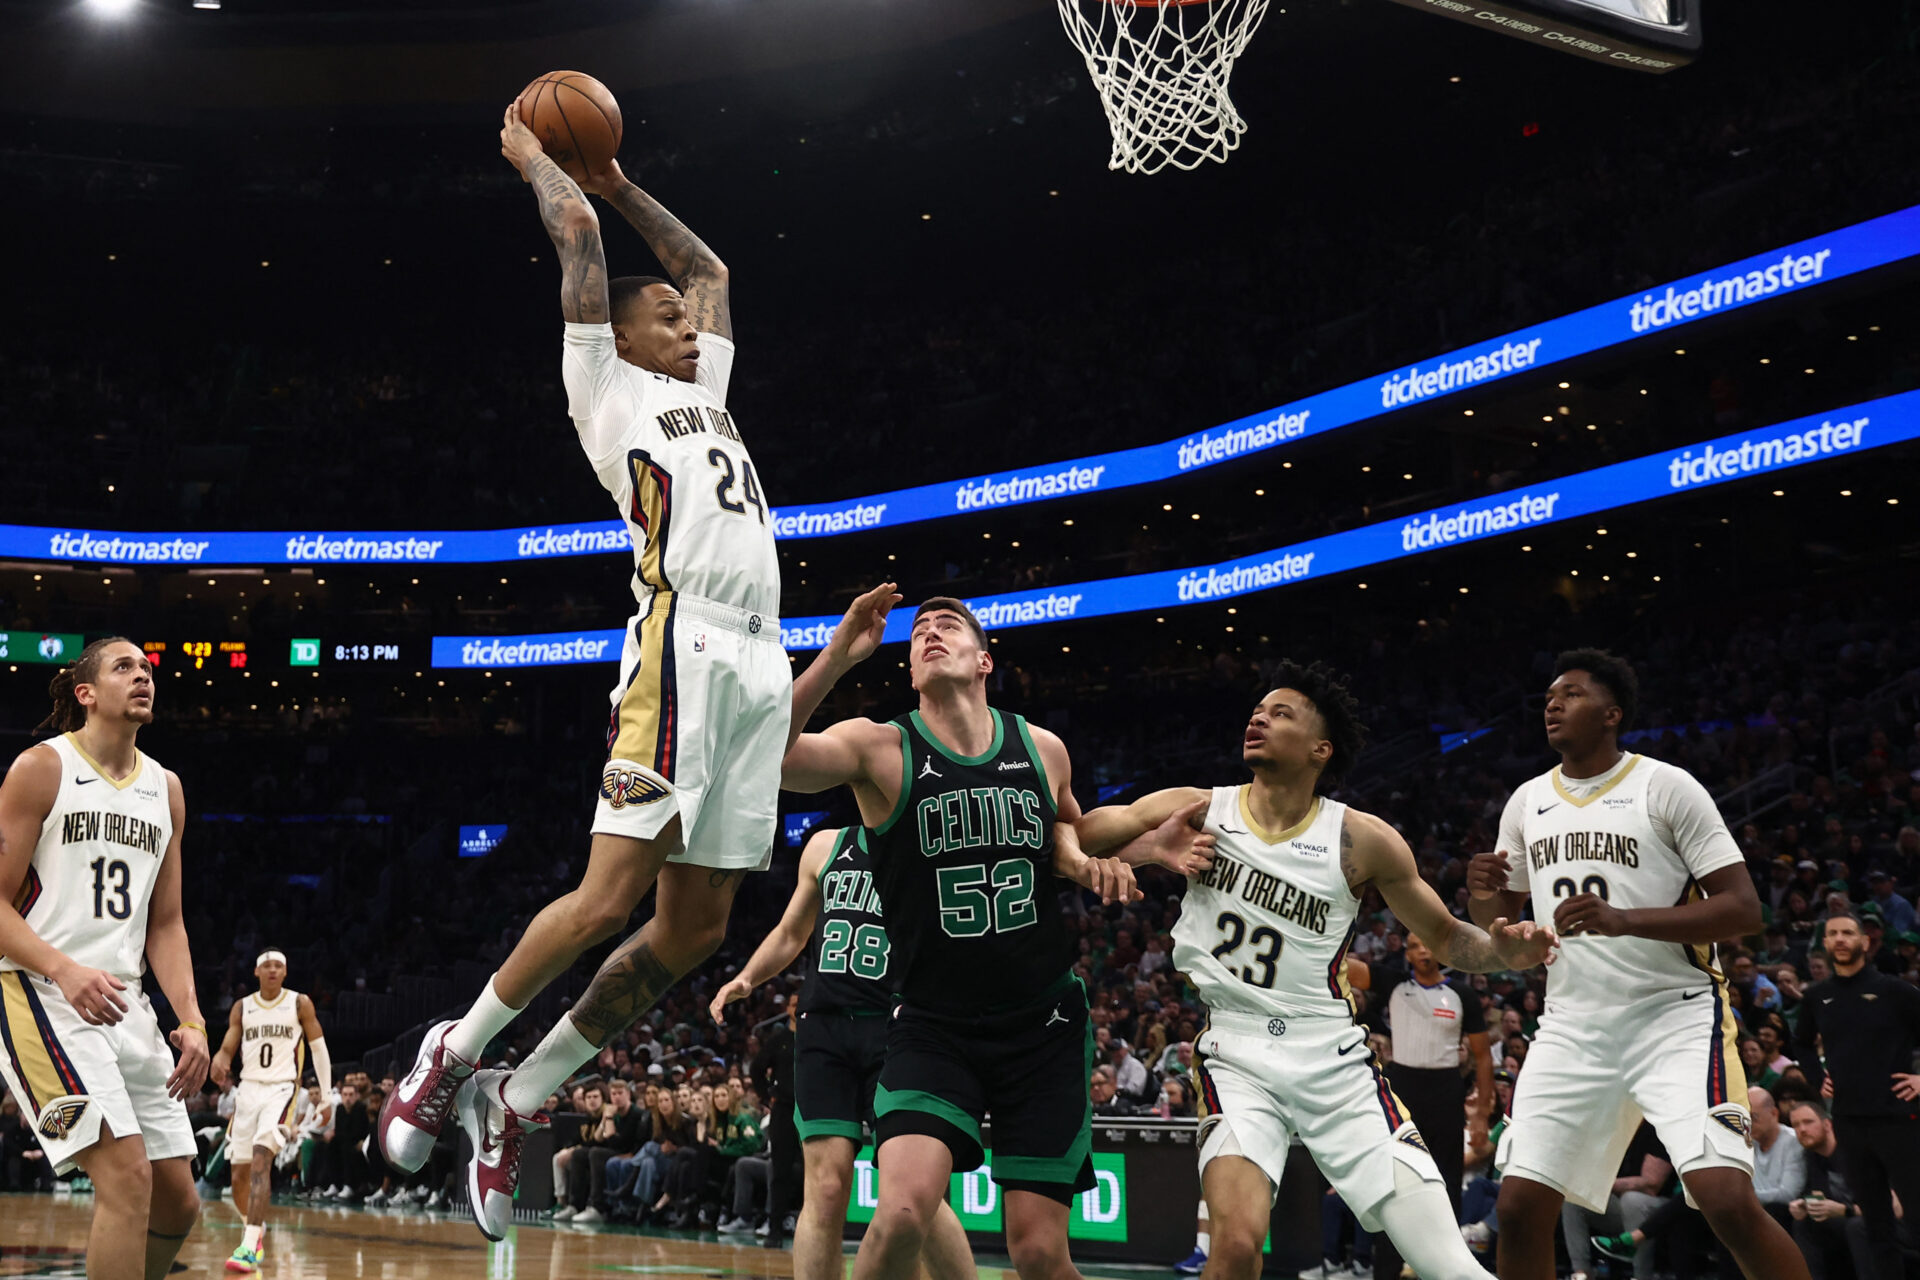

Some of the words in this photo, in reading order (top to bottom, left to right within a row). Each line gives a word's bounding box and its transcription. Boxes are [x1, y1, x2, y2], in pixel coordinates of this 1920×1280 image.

[1629, 248, 1831, 333] ticketmaster
[1380, 338, 1542, 408] ticketmaster
[656, 406, 707, 441] NEW
[705, 406, 744, 445] ORL
[1177, 410, 1311, 470] ticketmaster
[1668, 417, 1870, 488] ticketmaster
[708, 447, 766, 528] 24
[955, 465, 1105, 511] ticketmaster
[1401, 492, 1560, 551] ticketmaster
[50, 531, 210, 561] ticketmaster
[286, 534, 443, 560] ticketmaster
[1177, 552, 1315, 601] ticketmaster
[293, 643, 318, 661] TD
[334, 645, 370, 660] 8:13
[373, 645, 399, 660] PM
[462, 637, 609, 665] ticketmaster
[998, 760, 1030, 771] Amica
[62, 811, 101, 846] NEW
[104, 812, 162, 858] ORLEANS
[917, 787, 1043, 858] CELTICS
[1291, 841, 1329, 854] NEWAGE
[1529, 835, 1560, 873] NEW
[1565, 832, 1639, 868] ORLEANS
[90, 856, 132, 923] 13
[936, 858, 1037, 938] 52
[1242, 868, 1330, 935] ORLEANS
[818, 919, 891, 980] 28
[1211, 911, 1284, 989] 23
[260, 1043, 273, 1068] 0
[261, 1024, 294, 1040] ORLEANS
